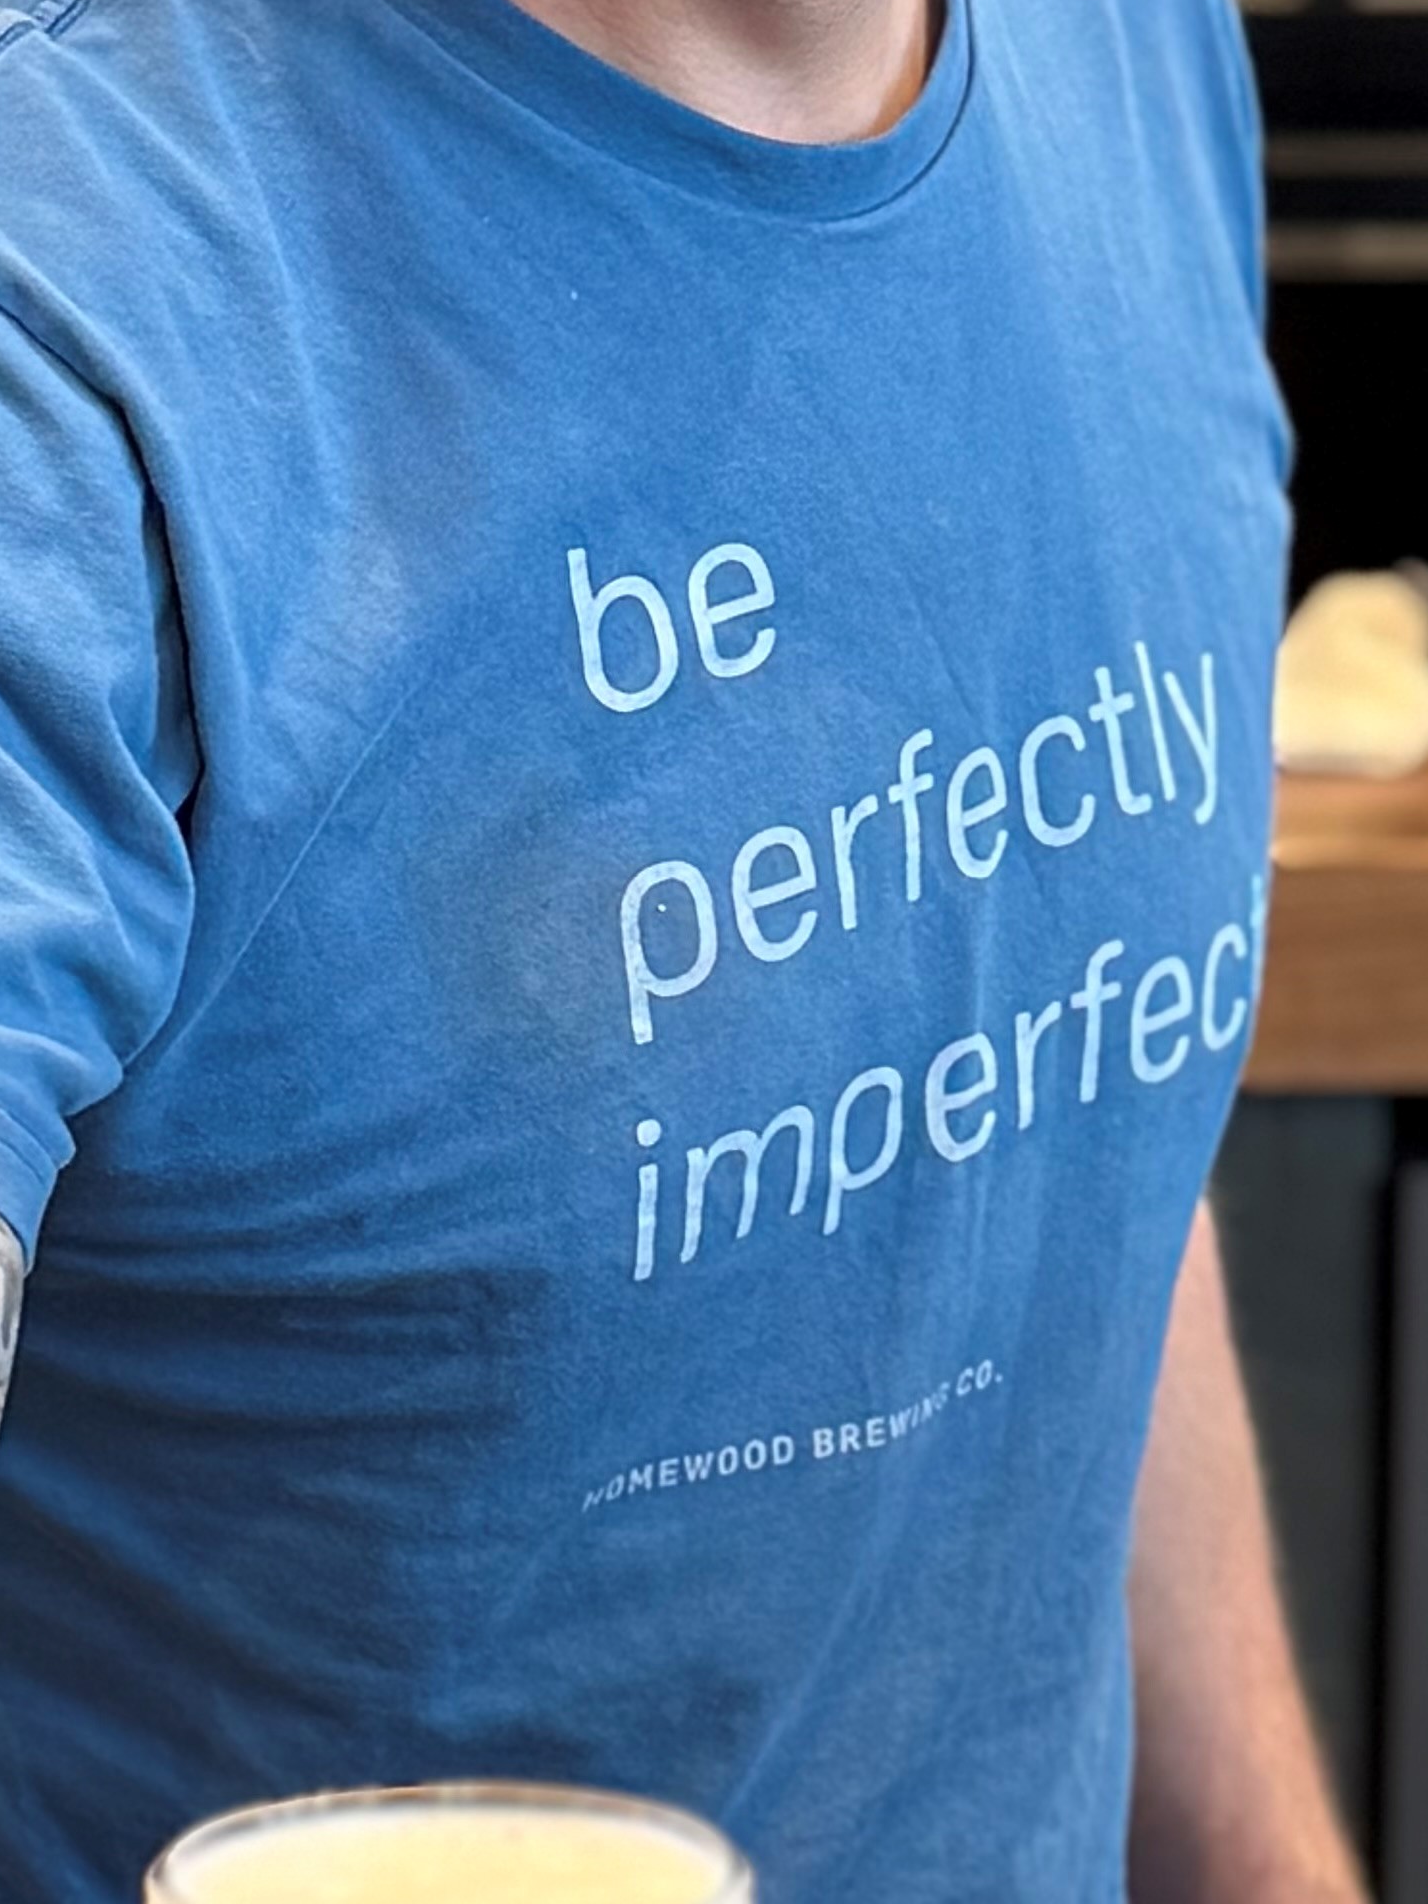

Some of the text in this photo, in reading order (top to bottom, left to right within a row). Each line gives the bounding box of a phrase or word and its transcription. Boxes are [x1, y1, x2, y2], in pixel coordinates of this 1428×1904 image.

[567, 542, 777, 713] be
[619, 640, 1219, 1045] perfectly
[812, 1381, 951, 1460] BREWING
[955, 1358, 1004, 1396] CO.
